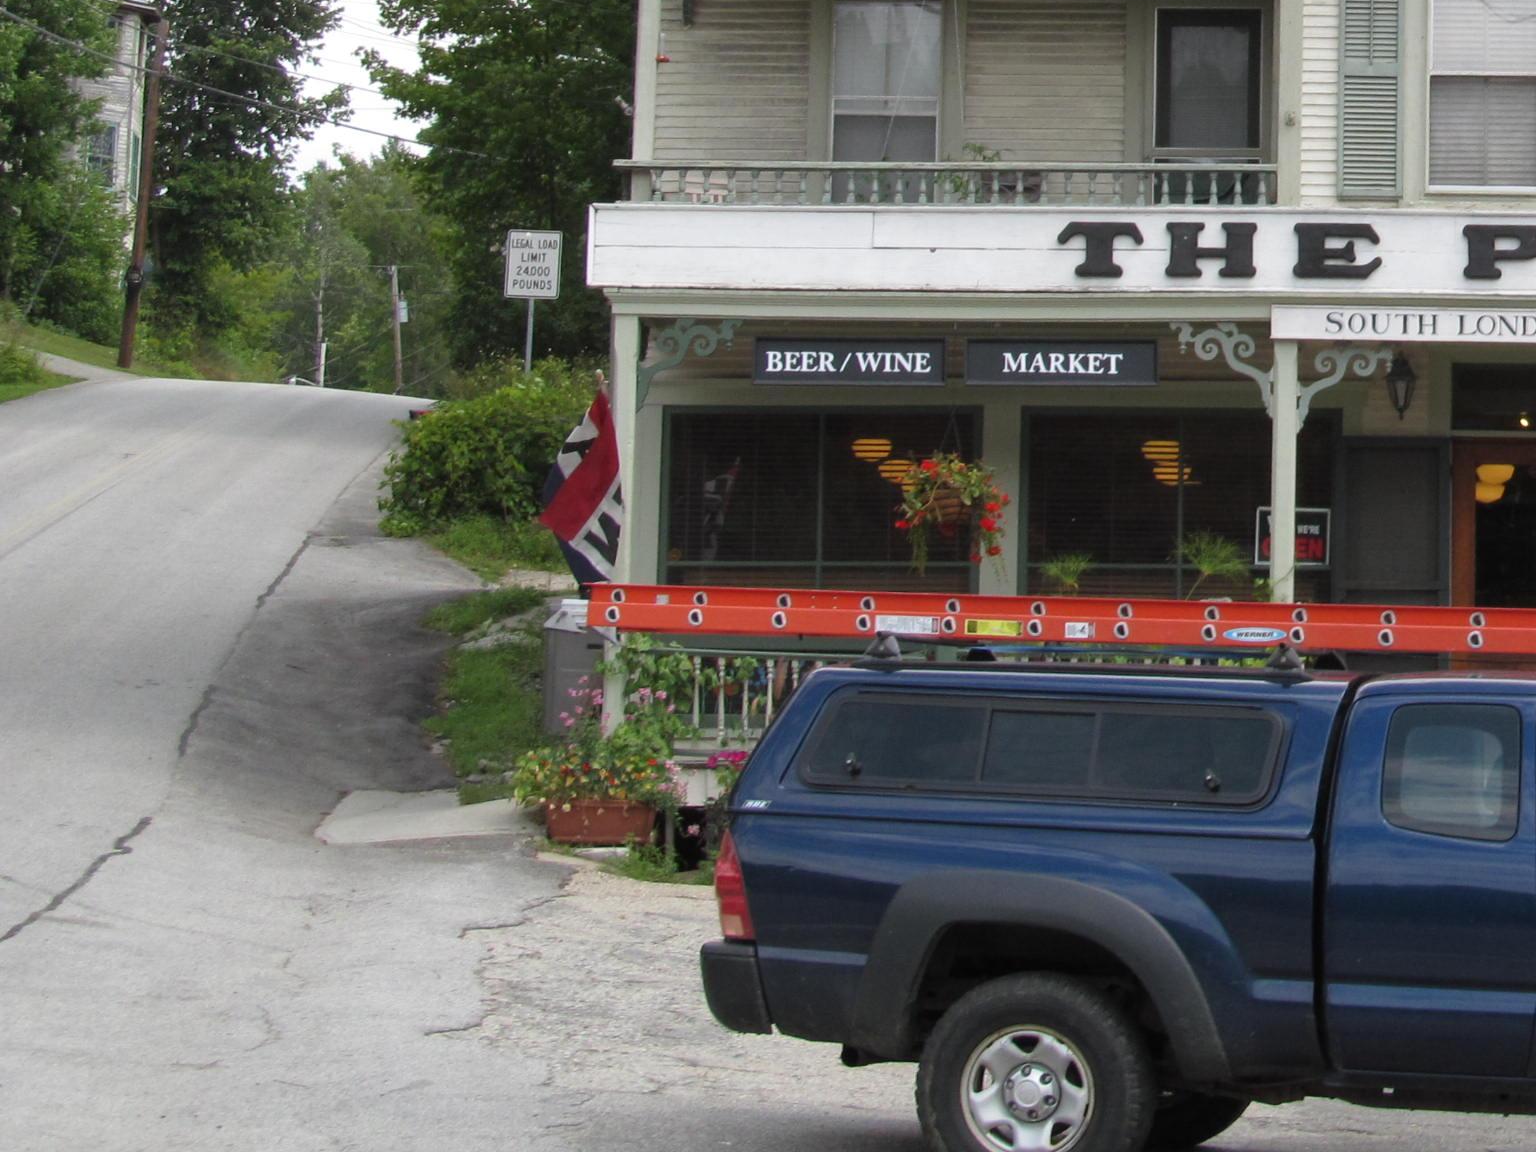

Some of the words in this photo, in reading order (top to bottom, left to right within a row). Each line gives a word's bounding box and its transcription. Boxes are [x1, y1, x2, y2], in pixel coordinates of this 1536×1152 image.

[511, 239, 533, 249] LEGAL
[538, 239, 558, 250] LOAD
[1057, 221, 1383, 280] THE
[521, 252, 546, 263] LIMIT
[512, 279, 552, 290] POUNDS
[1325, 311, 1438, 336] SOUTH
[1002, 352, 1123, 375] MARKET
